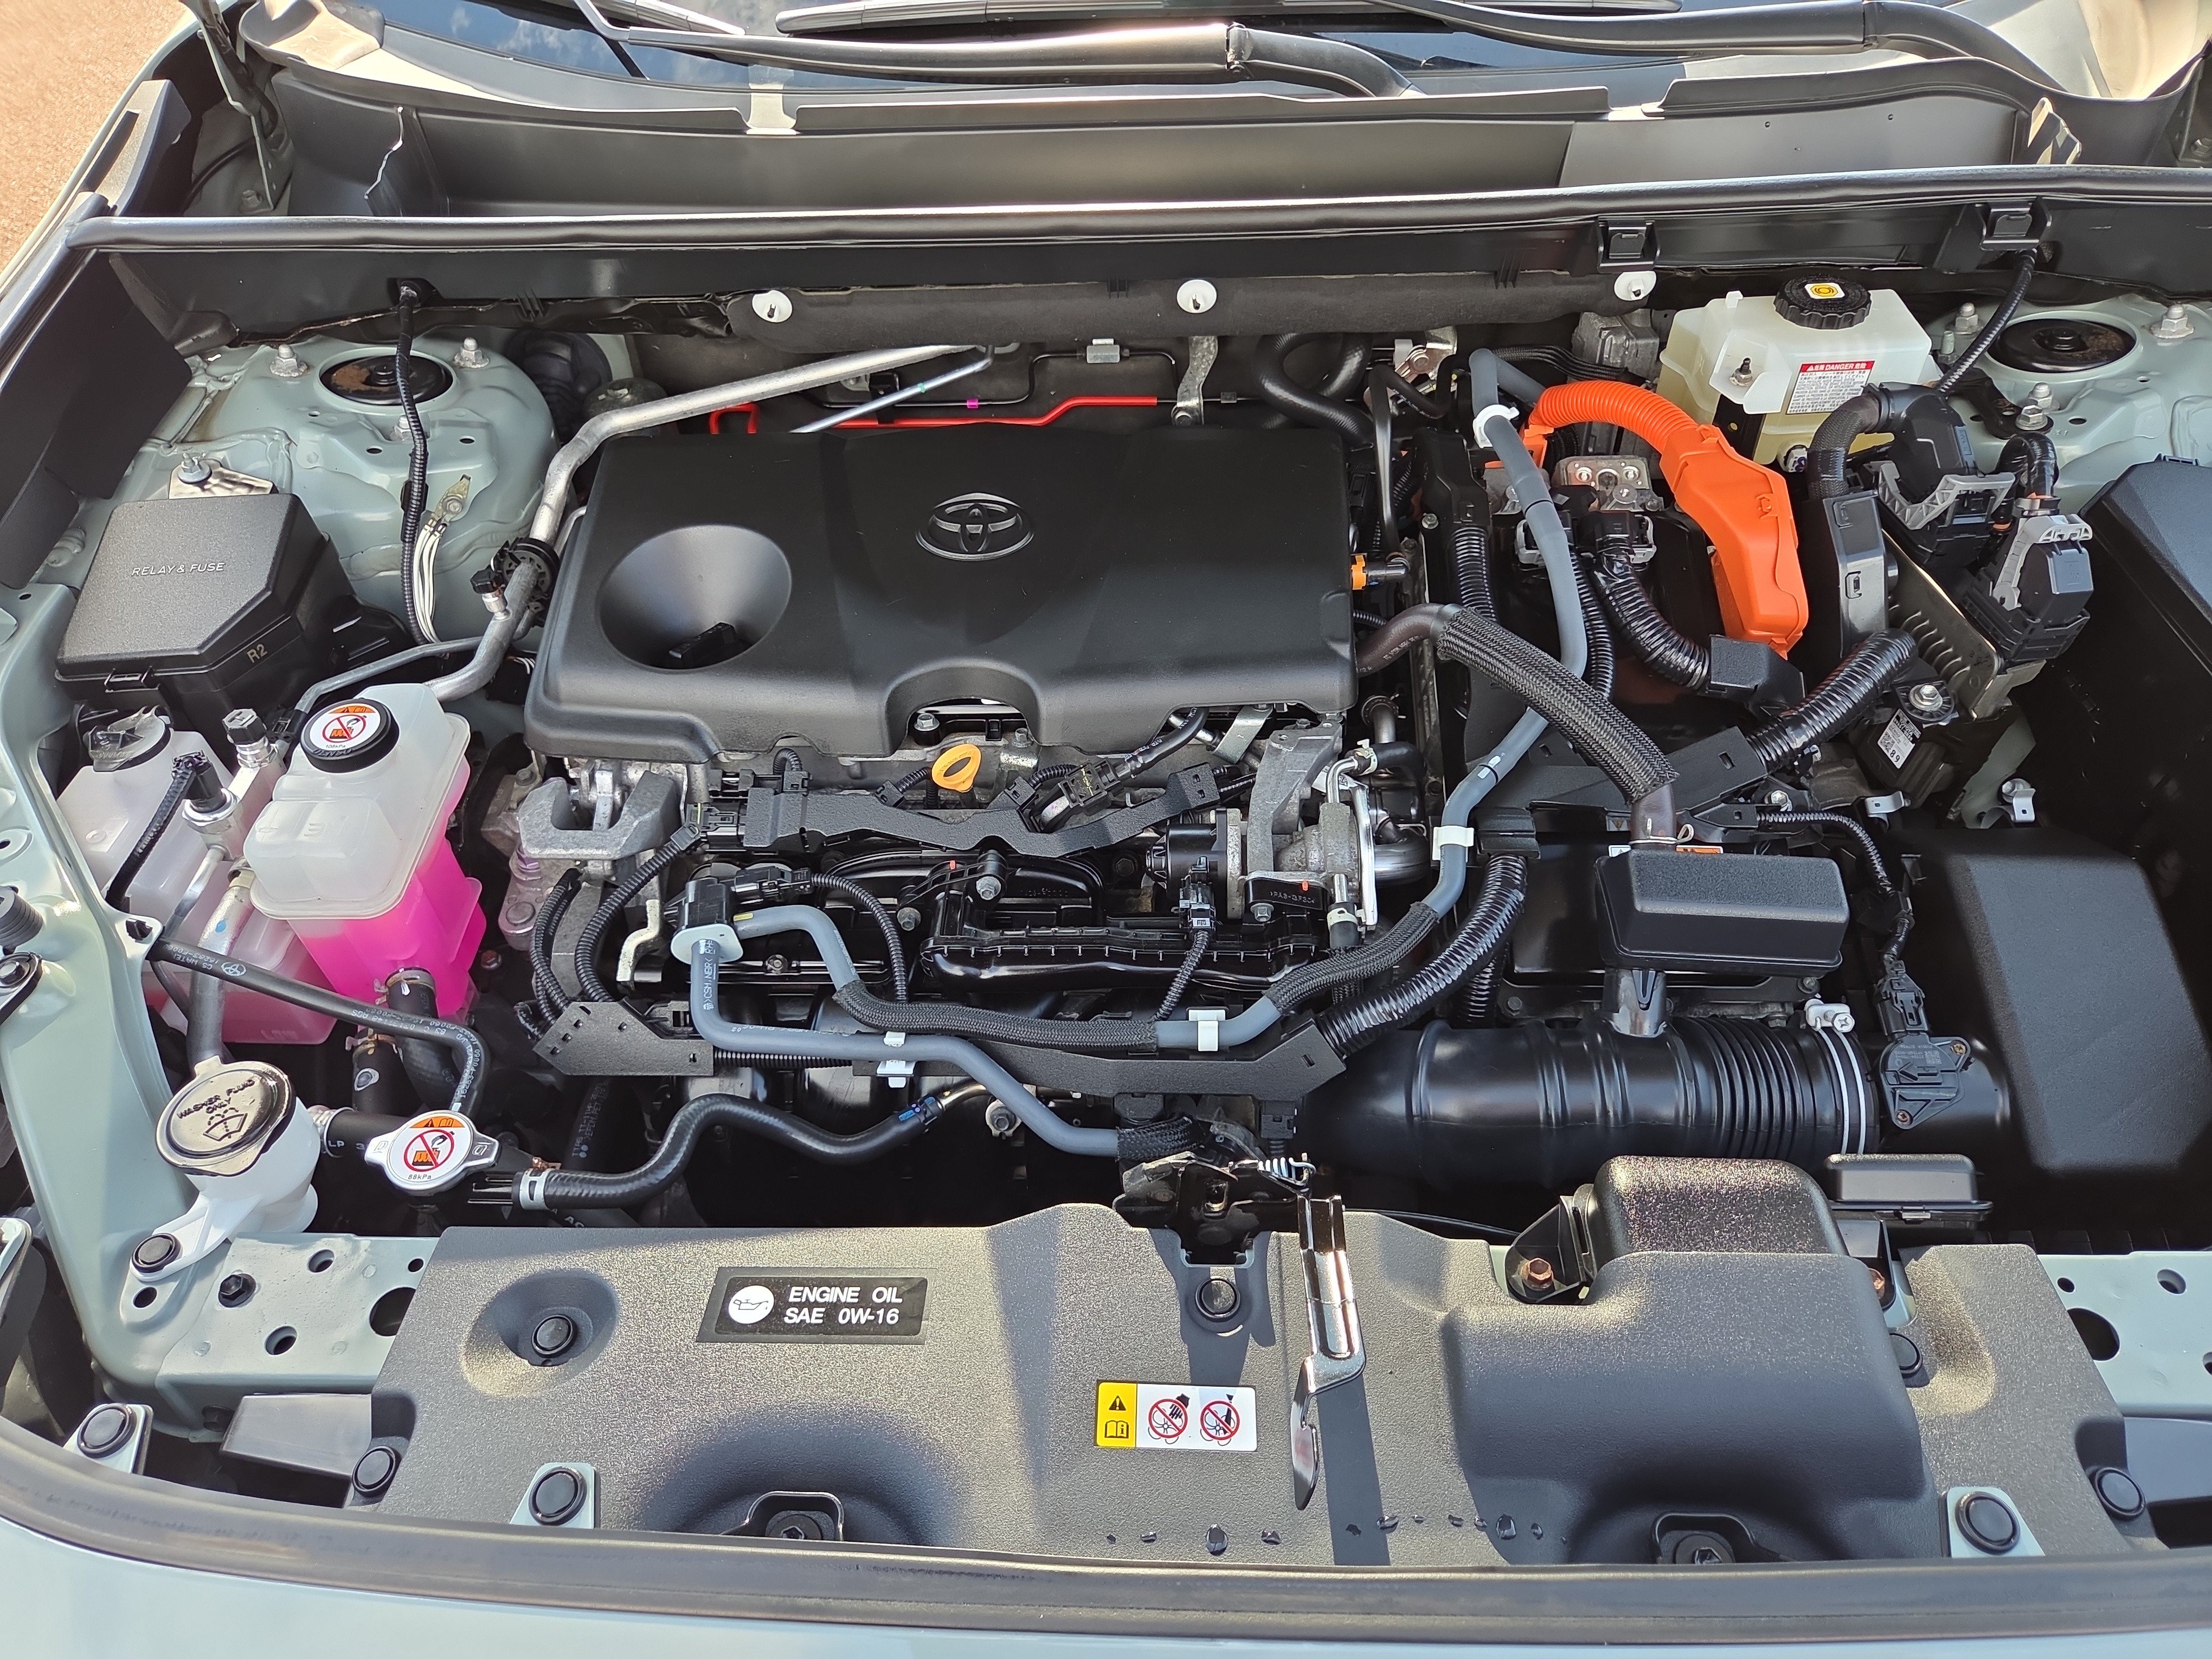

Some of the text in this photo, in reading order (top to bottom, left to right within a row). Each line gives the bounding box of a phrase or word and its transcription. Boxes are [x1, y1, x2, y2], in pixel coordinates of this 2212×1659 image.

[1825, 363, 1854, 371] DANGER
[131, 562, 226, 576] RELAY & FUSE
[247, 644, 268, 663] R2
[173, 953, 198, 966] WATE
[177, 1079, 256, 1119] WASHER FLUID
[205, 1097, 232, 1120] ONLY
[788, 1286, 903, 1304] ENGINE OIL
[784, 1307, 900, 1324] SAE 0W-16
